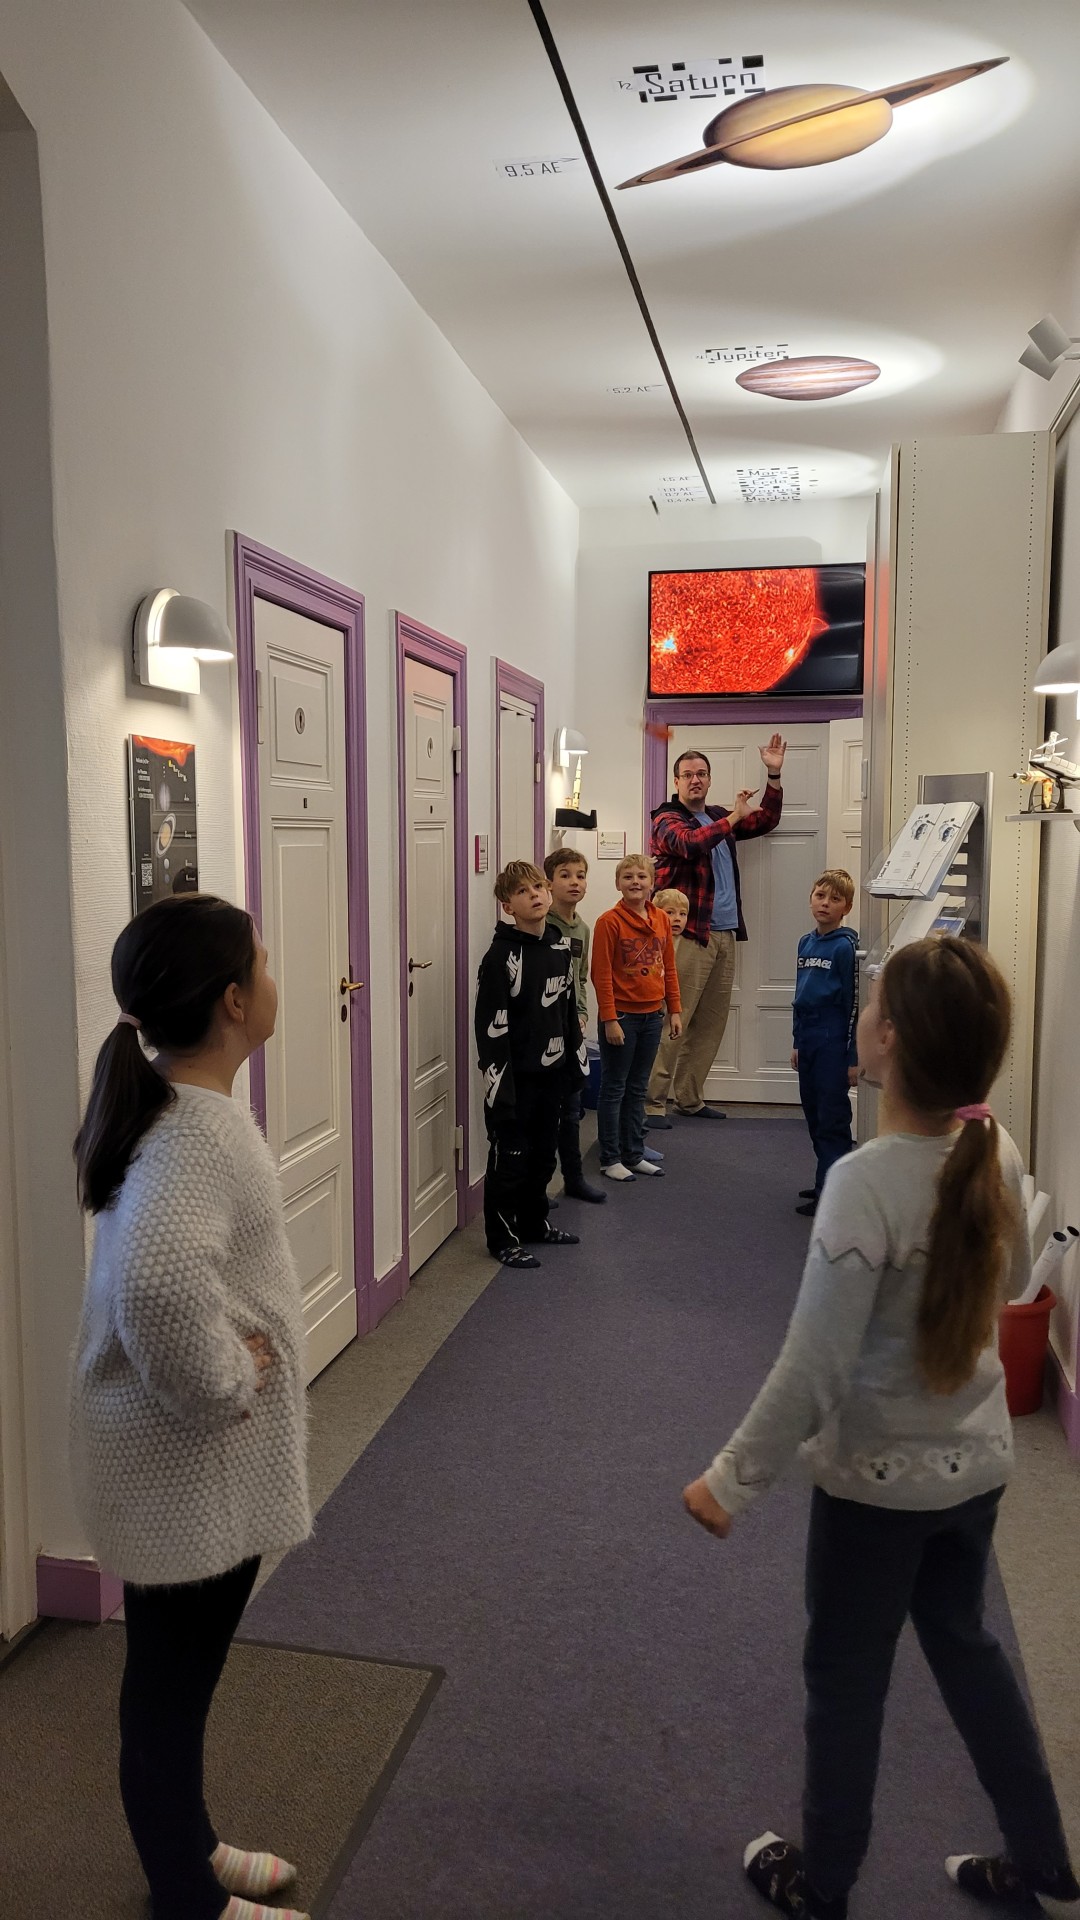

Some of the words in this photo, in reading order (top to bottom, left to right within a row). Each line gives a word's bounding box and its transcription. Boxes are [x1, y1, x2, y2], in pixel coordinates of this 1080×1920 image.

[644, 72, 757, 94] Saturn
[504, 163, 534, 177] 9.5
[541, 161, 562, 174] AE
[710, 350, 786, 361] Jupiter
[545, 976, 567, 995] NIKE
